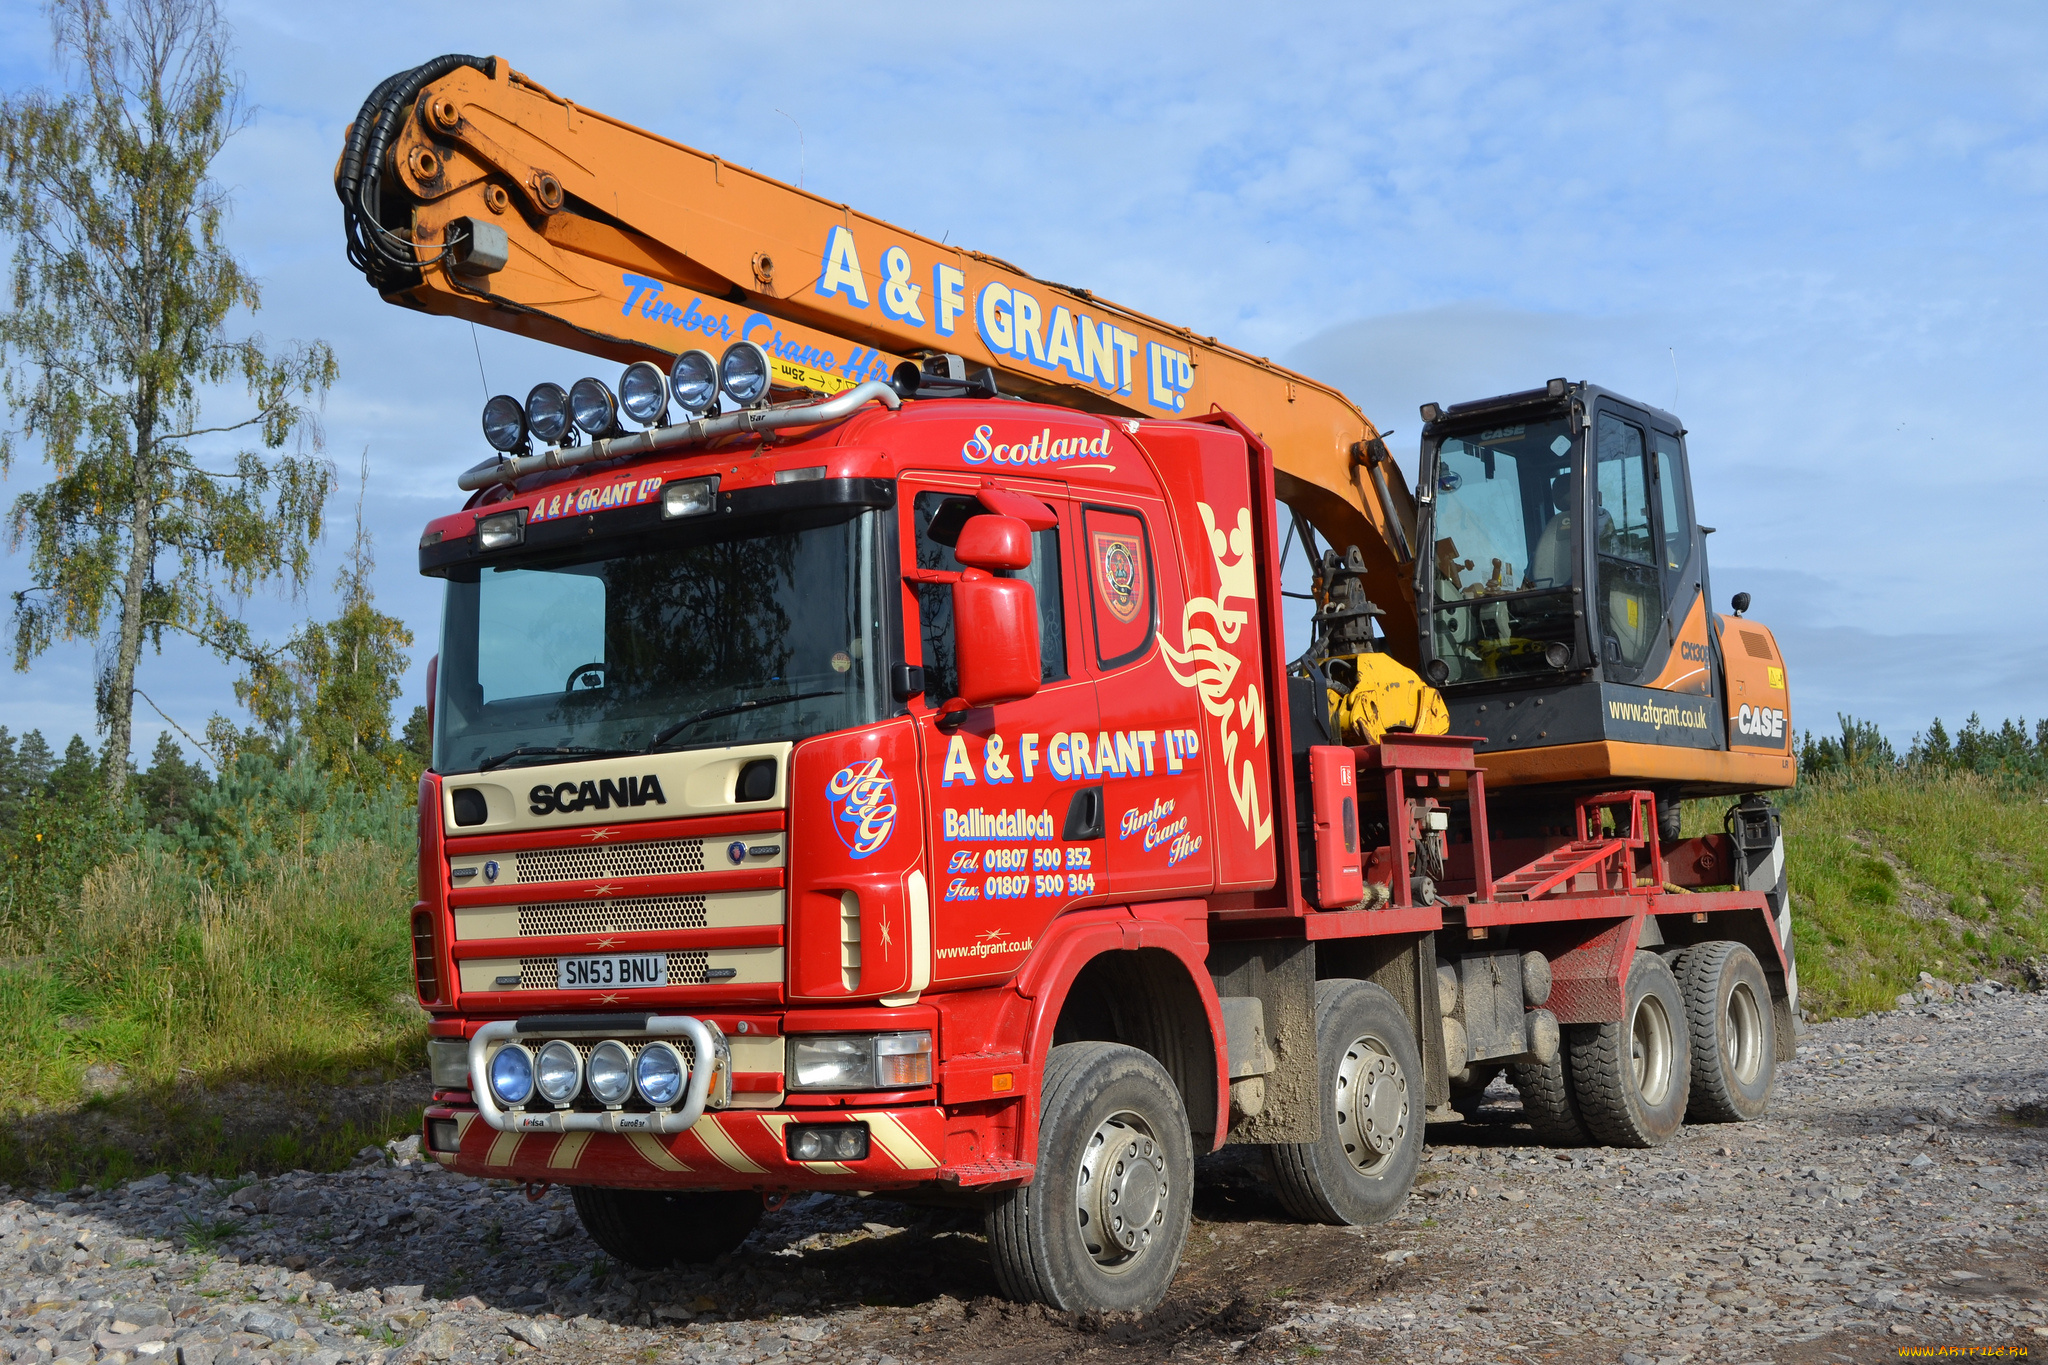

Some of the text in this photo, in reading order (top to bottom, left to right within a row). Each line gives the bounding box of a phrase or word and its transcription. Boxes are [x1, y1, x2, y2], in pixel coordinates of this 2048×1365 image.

[621, 273, 894, 383] Timber Crane Hir
[816, 225, 869, 309] A
[879, 246, 925, 327] &
[934, 262, 965, 337] F
[977, 281, 1137, 396] GRANT
[781, 364, 805, 382] 25m
[962, 424, 1113, 466] Scotland
[1481, 424, 1525, 440] CASE
[530, 498, 546, 522] A
[547, 495, 561, 519] &
[563, 493, 574, 516] F
[576, 481, 637, 514] GRANT
[1609, 698, 1707, 730] www.afgrant.co.uk
[1738, 703, 1783, 738] CASE
[941, 735, 977, 787] A
[983, 734, 1014, 784] &
[1020, 732, 1040, 782] F
[1048, 729, 1156, 780] GRANT
[529, 774, 667, 816] SCANIA
[944, 808, 1054, 841] Ballindalloch
[1119, 798, 1176, 840] Timber
[1143, 816, 1188, 852] Crane
[947, 847, 1091, 874] Tel. 01807 500 352
[1168, 831, 1202, 867] Hire
[984, 875, 1030, 900] 01807
[1035, 874, 1064, 897] 500
[1067, 873, 1095, 896] 364
[937, 936, 1033, 959] www.afgrant.co.uk
[566, 958, 658, 984] SN53 BNU
